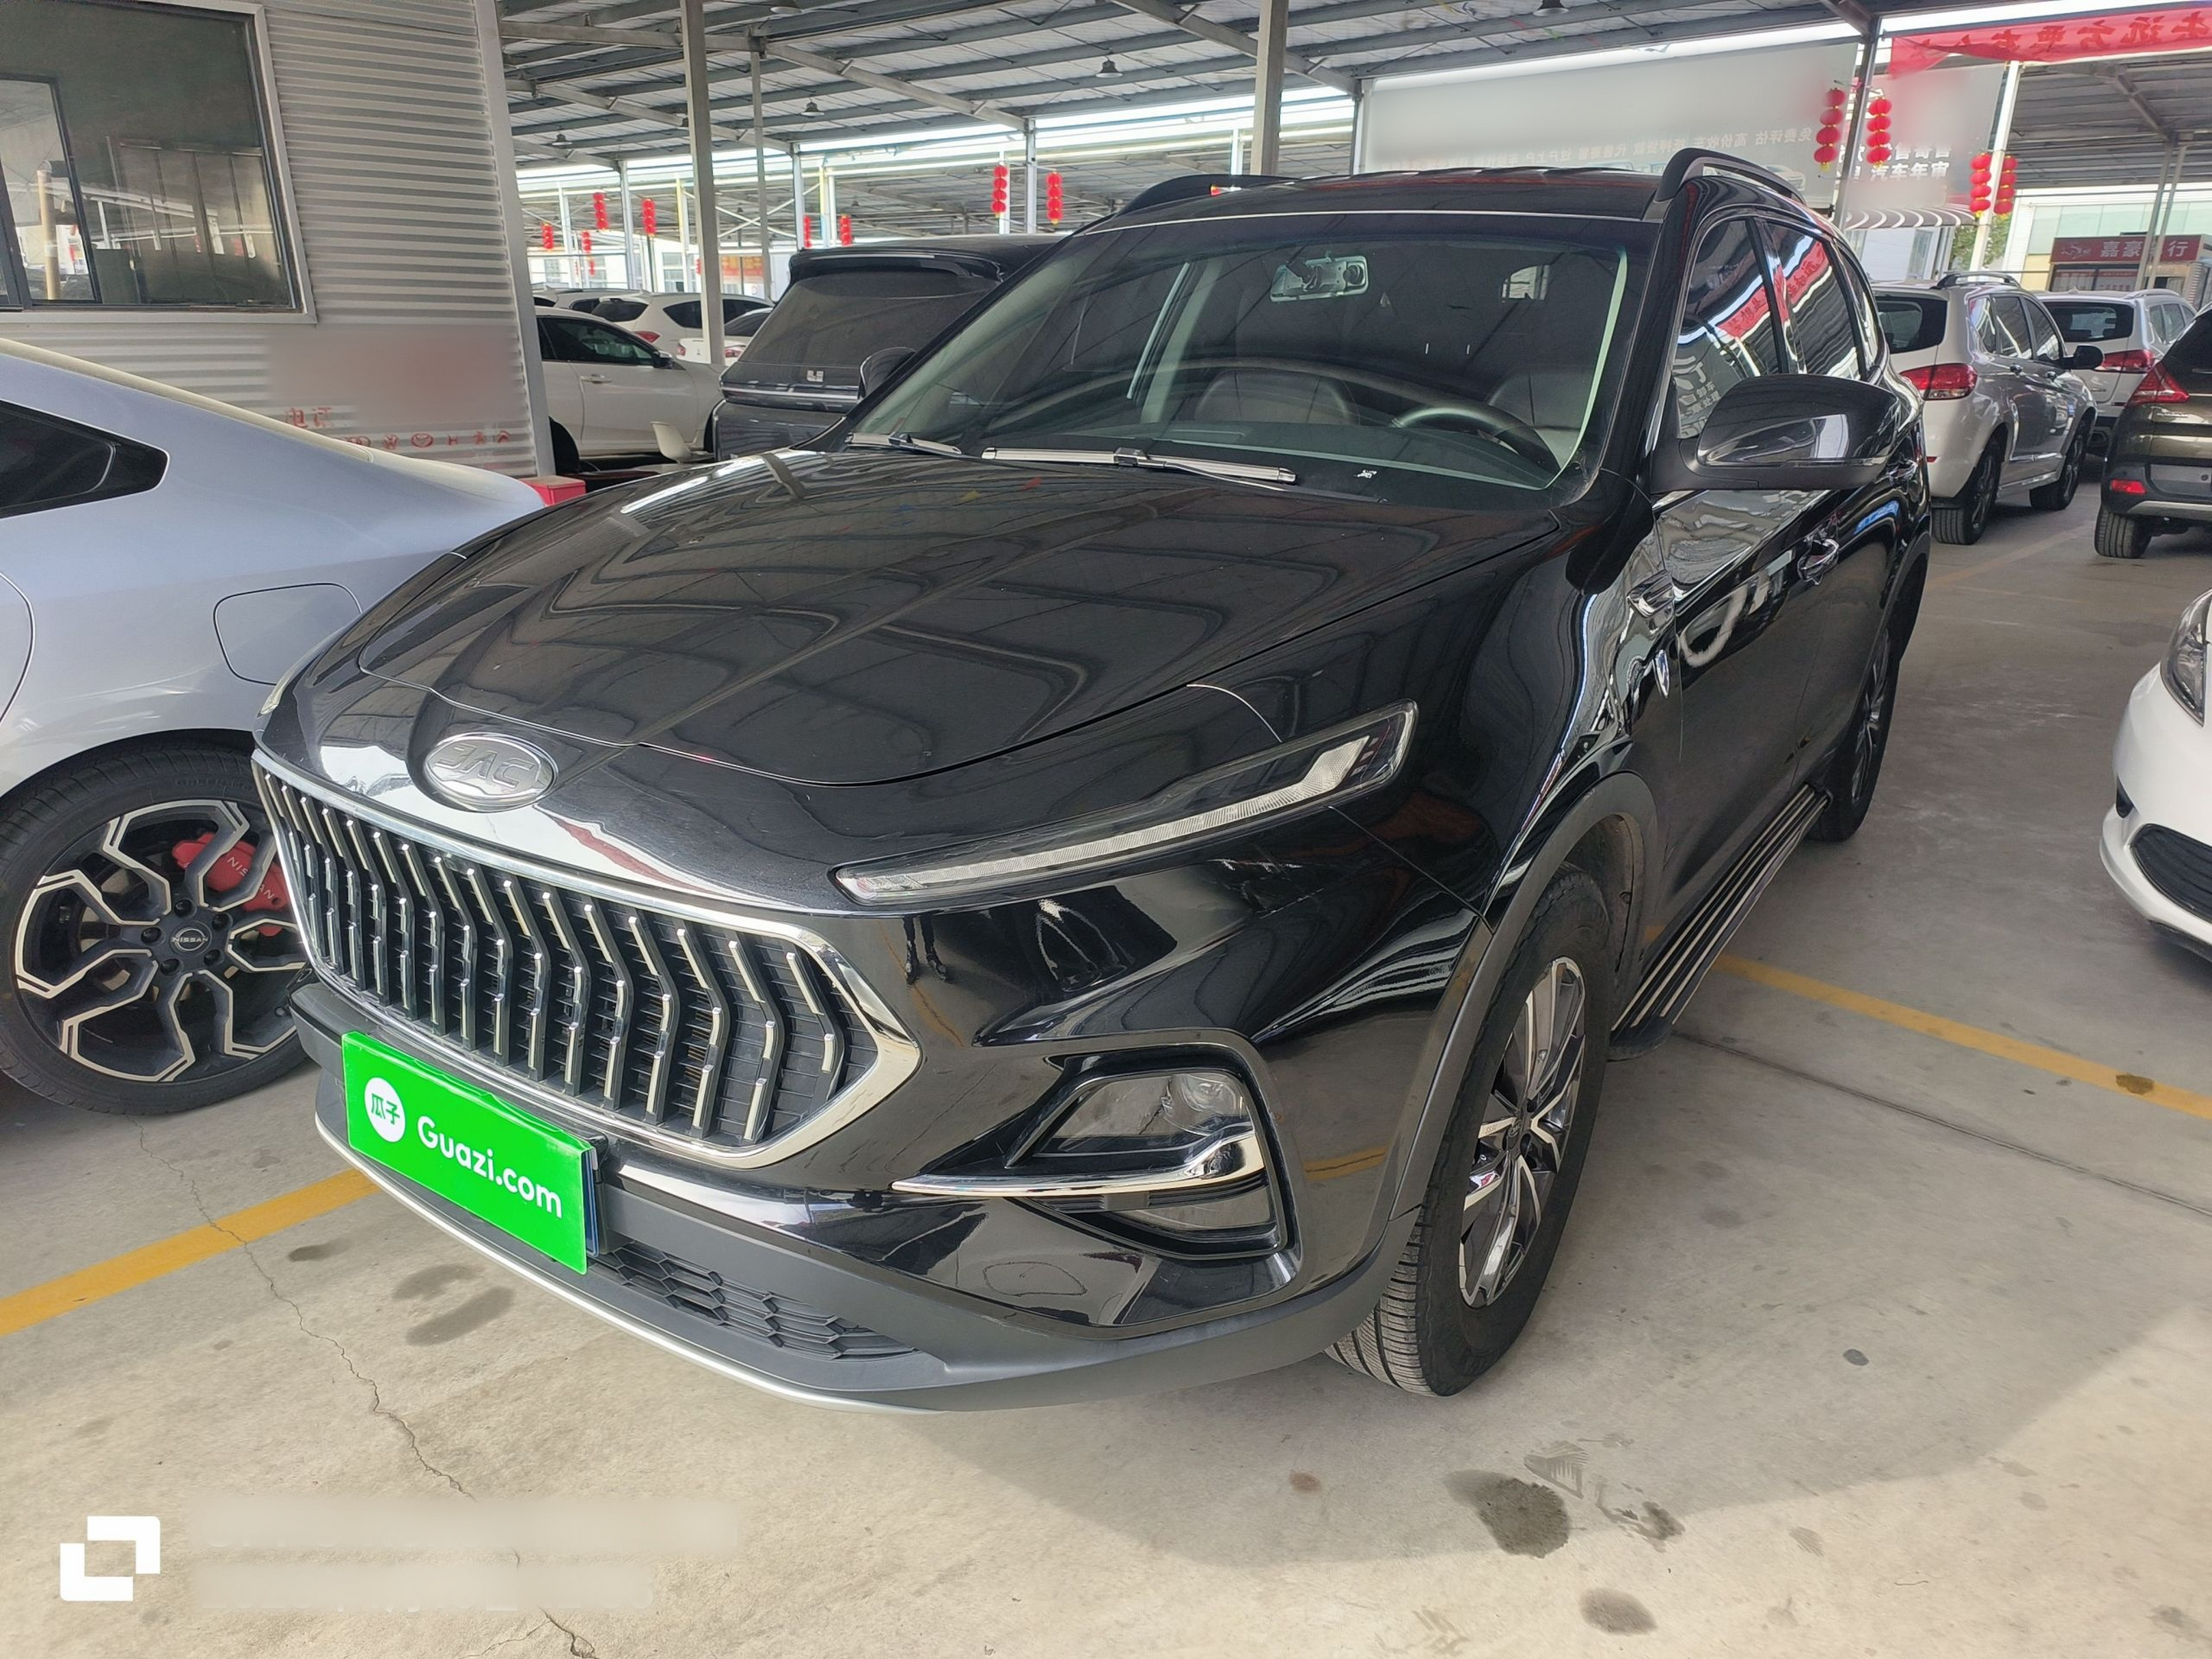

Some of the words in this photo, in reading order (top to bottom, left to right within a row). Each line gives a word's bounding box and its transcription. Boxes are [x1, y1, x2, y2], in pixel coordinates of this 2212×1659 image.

[2100, 240, 2188, 259] 嘉豪行
[435, 743, 535, 789] JAC
[370, 1092, 401, 1125] 瓜子
[416, 1116, 563, 1219] Guazi.com
